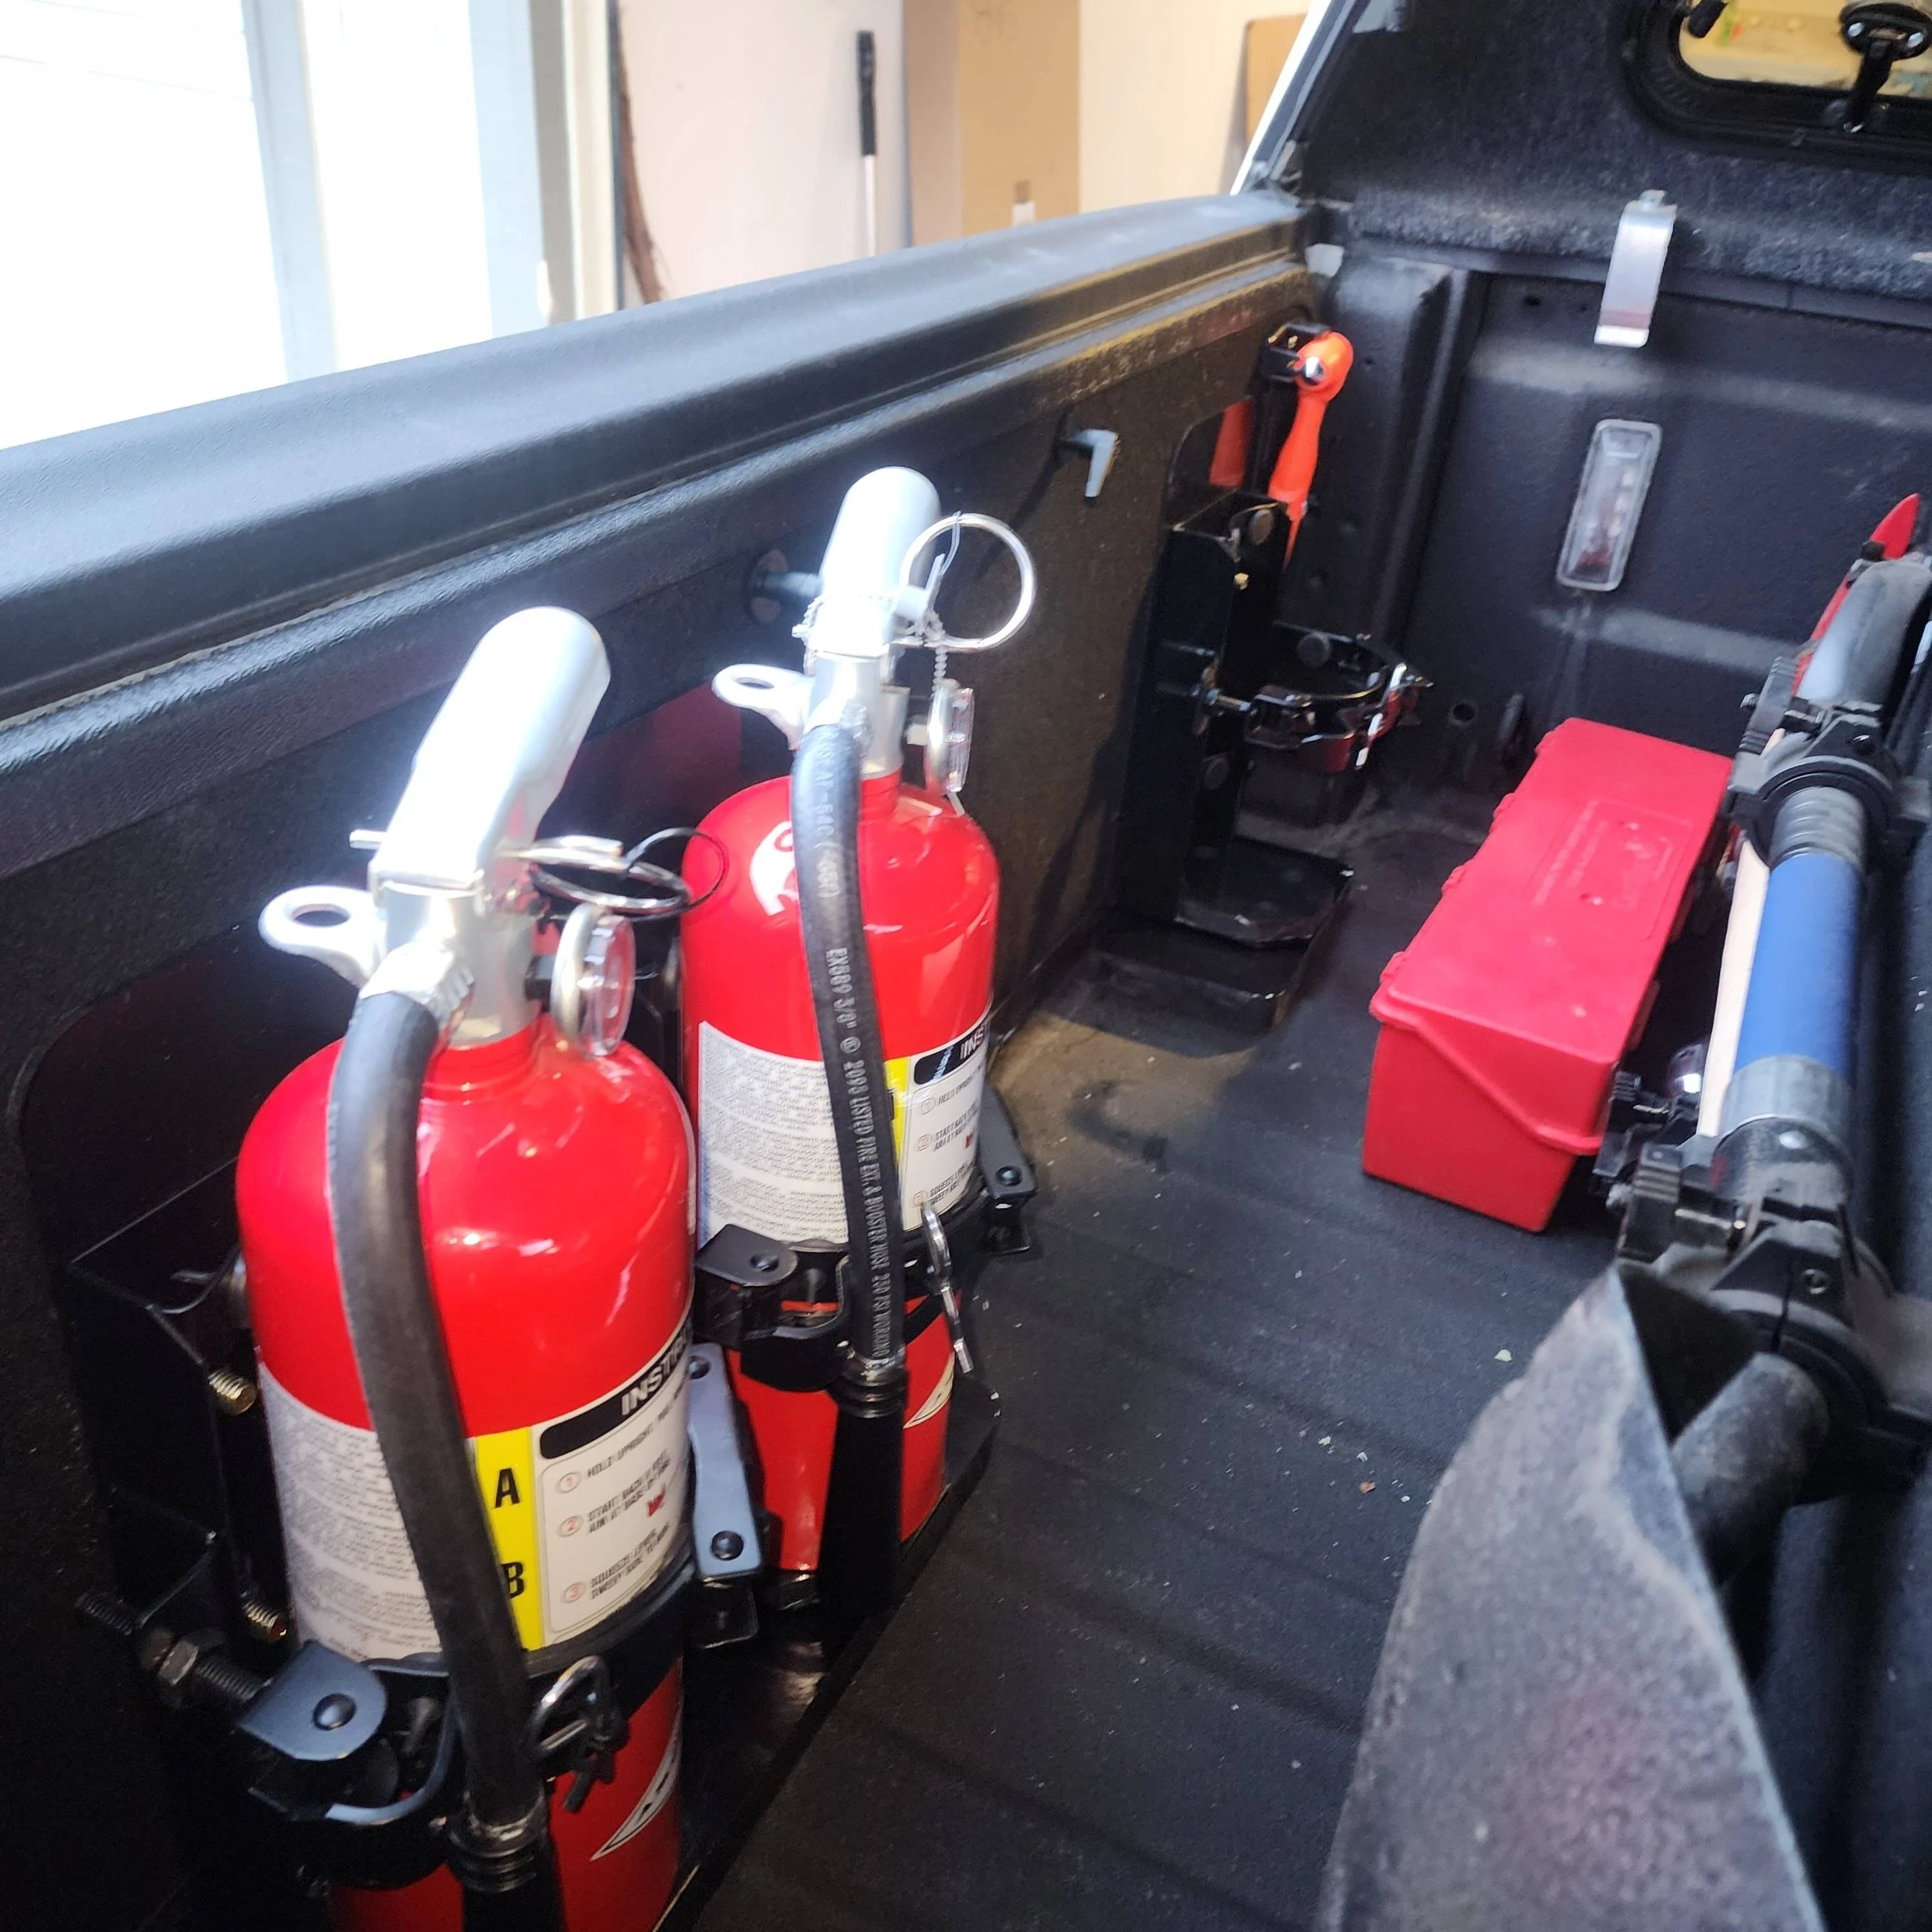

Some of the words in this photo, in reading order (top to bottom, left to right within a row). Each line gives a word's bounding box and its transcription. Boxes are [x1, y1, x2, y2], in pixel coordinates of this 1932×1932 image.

[849, 1096, 874, 1135] LISTED
[856, 1136, 878, 1162] FIRE
[864, 1196, 887, 1243] BOOSTER
[870, 1242, 890, 1270] HOSE
[872, 1310, 890, 1357] WORKING
[495, 1468, 520, 1509] A
[500, 1561, 525, 1599] B
